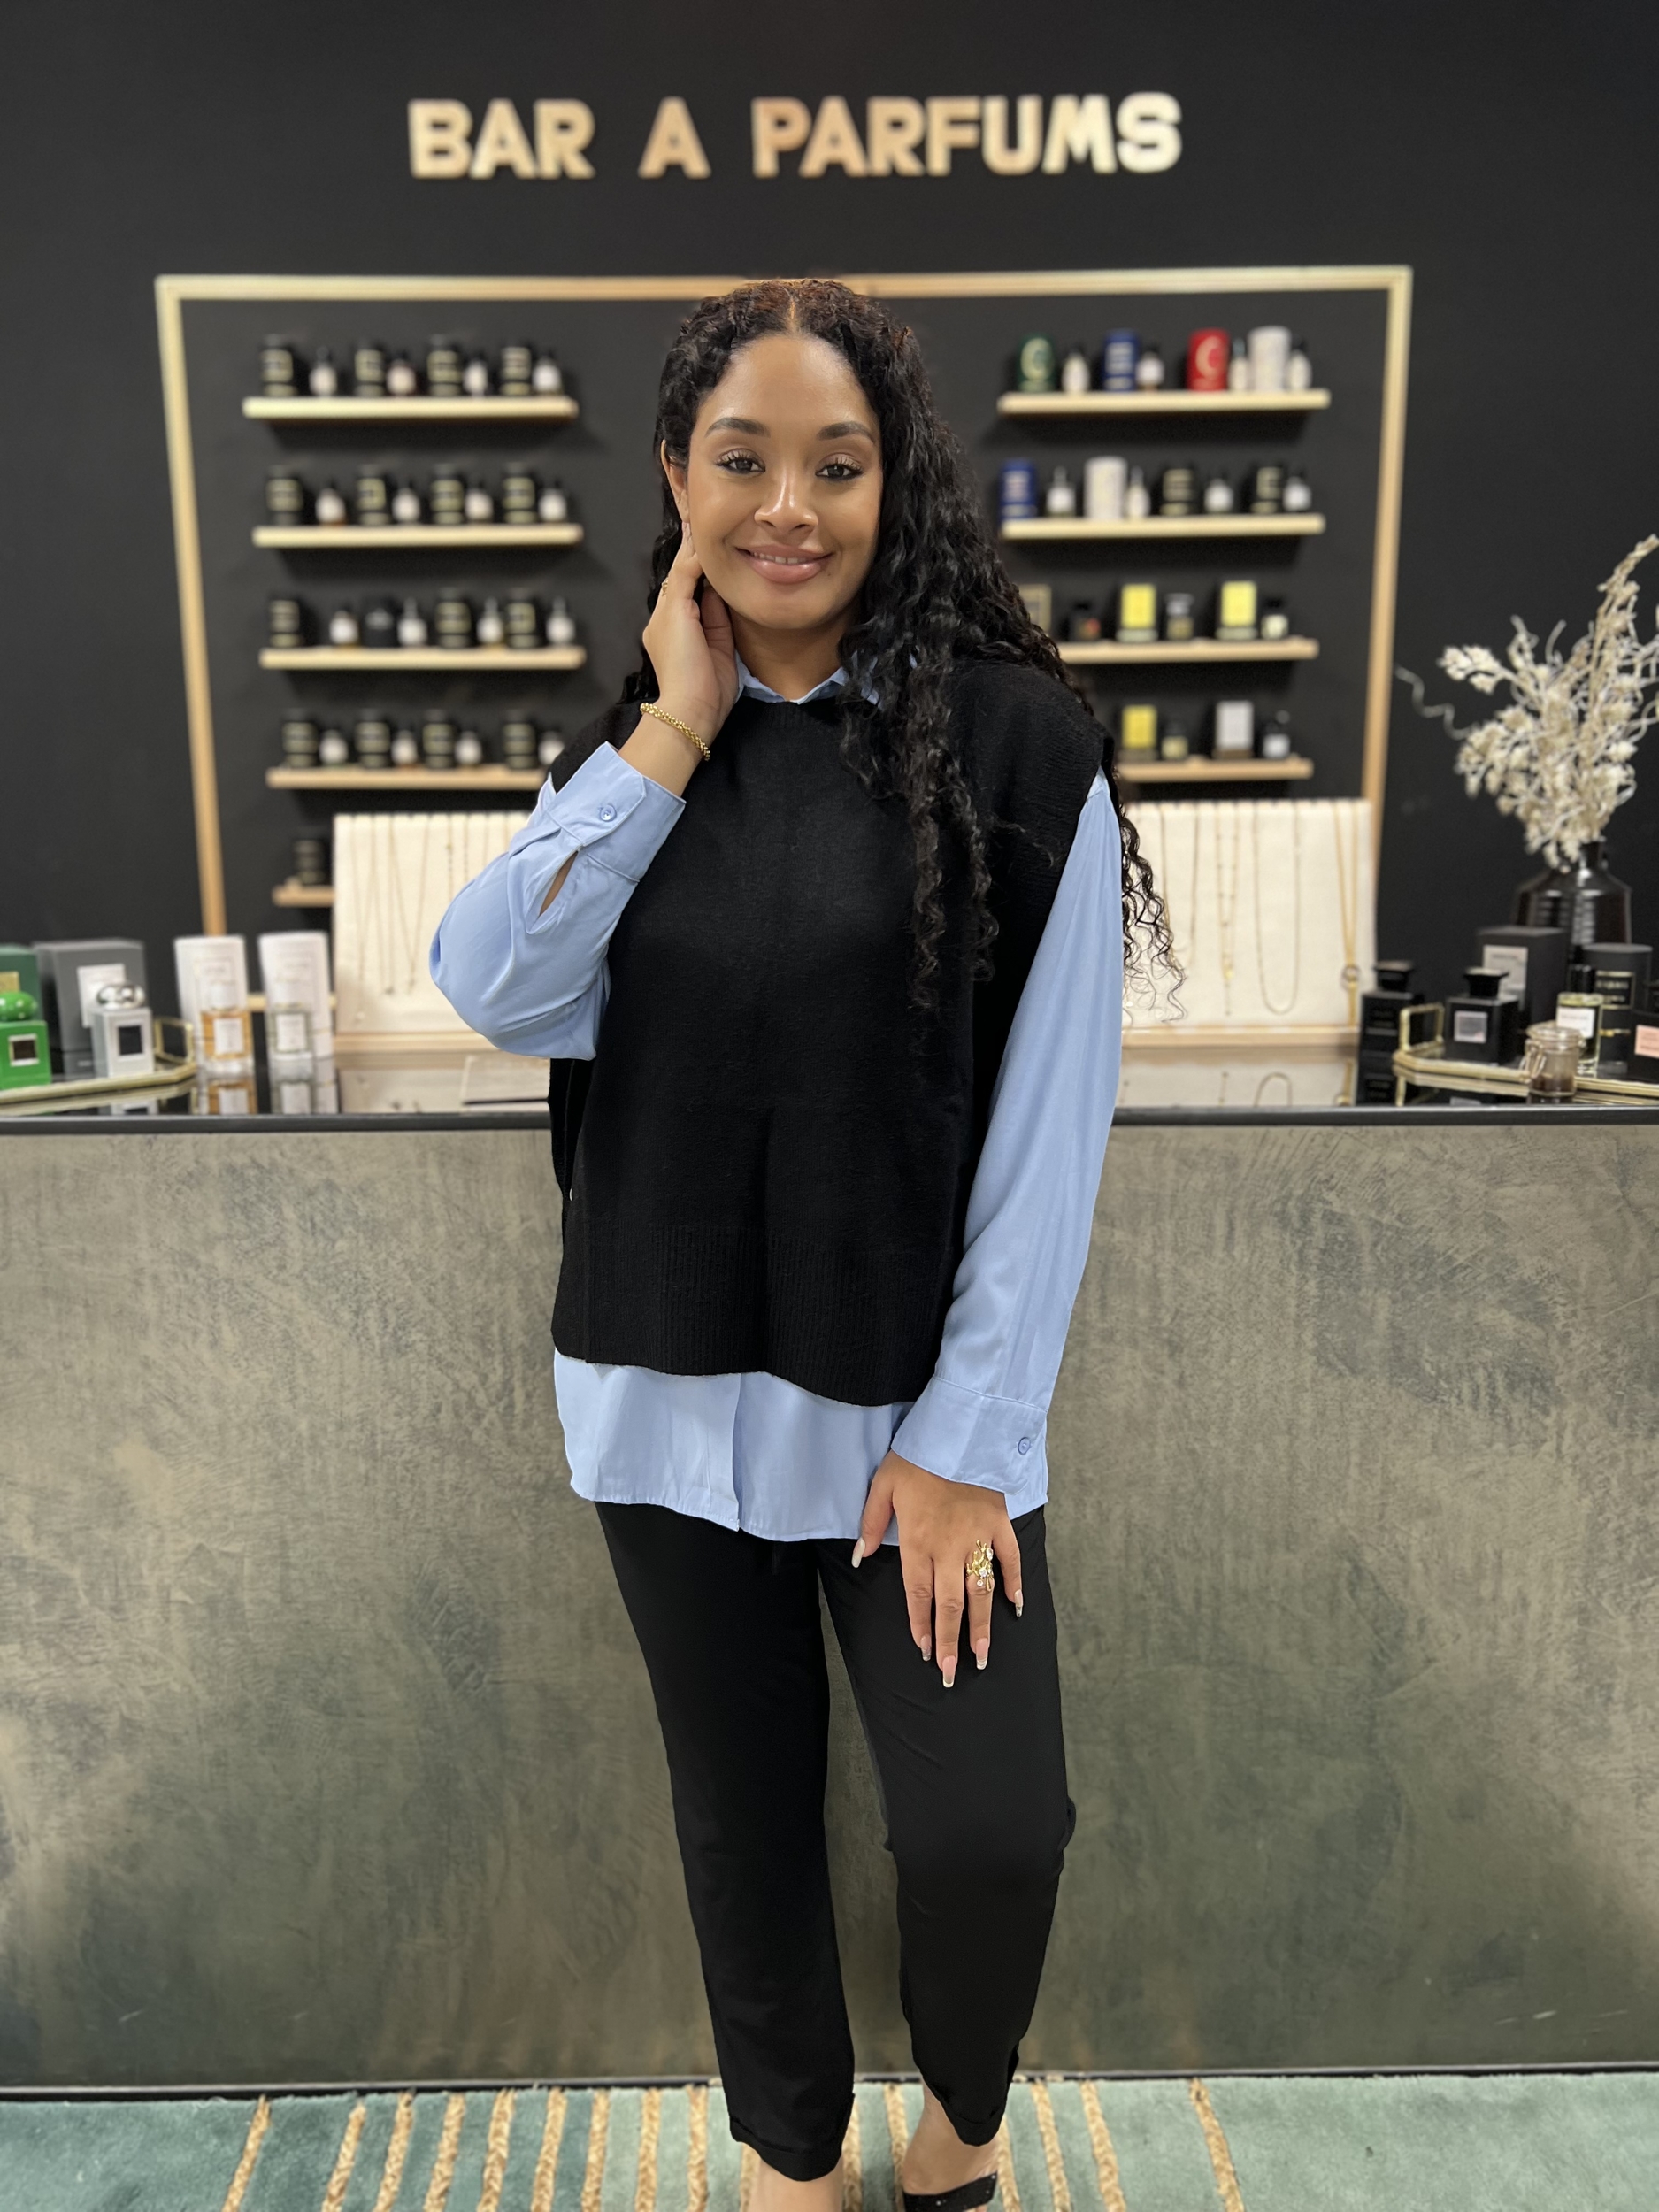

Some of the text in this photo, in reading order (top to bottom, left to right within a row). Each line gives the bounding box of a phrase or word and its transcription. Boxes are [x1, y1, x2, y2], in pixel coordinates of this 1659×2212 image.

[408, 91, 1182, 179] BAR A PARFUMS
